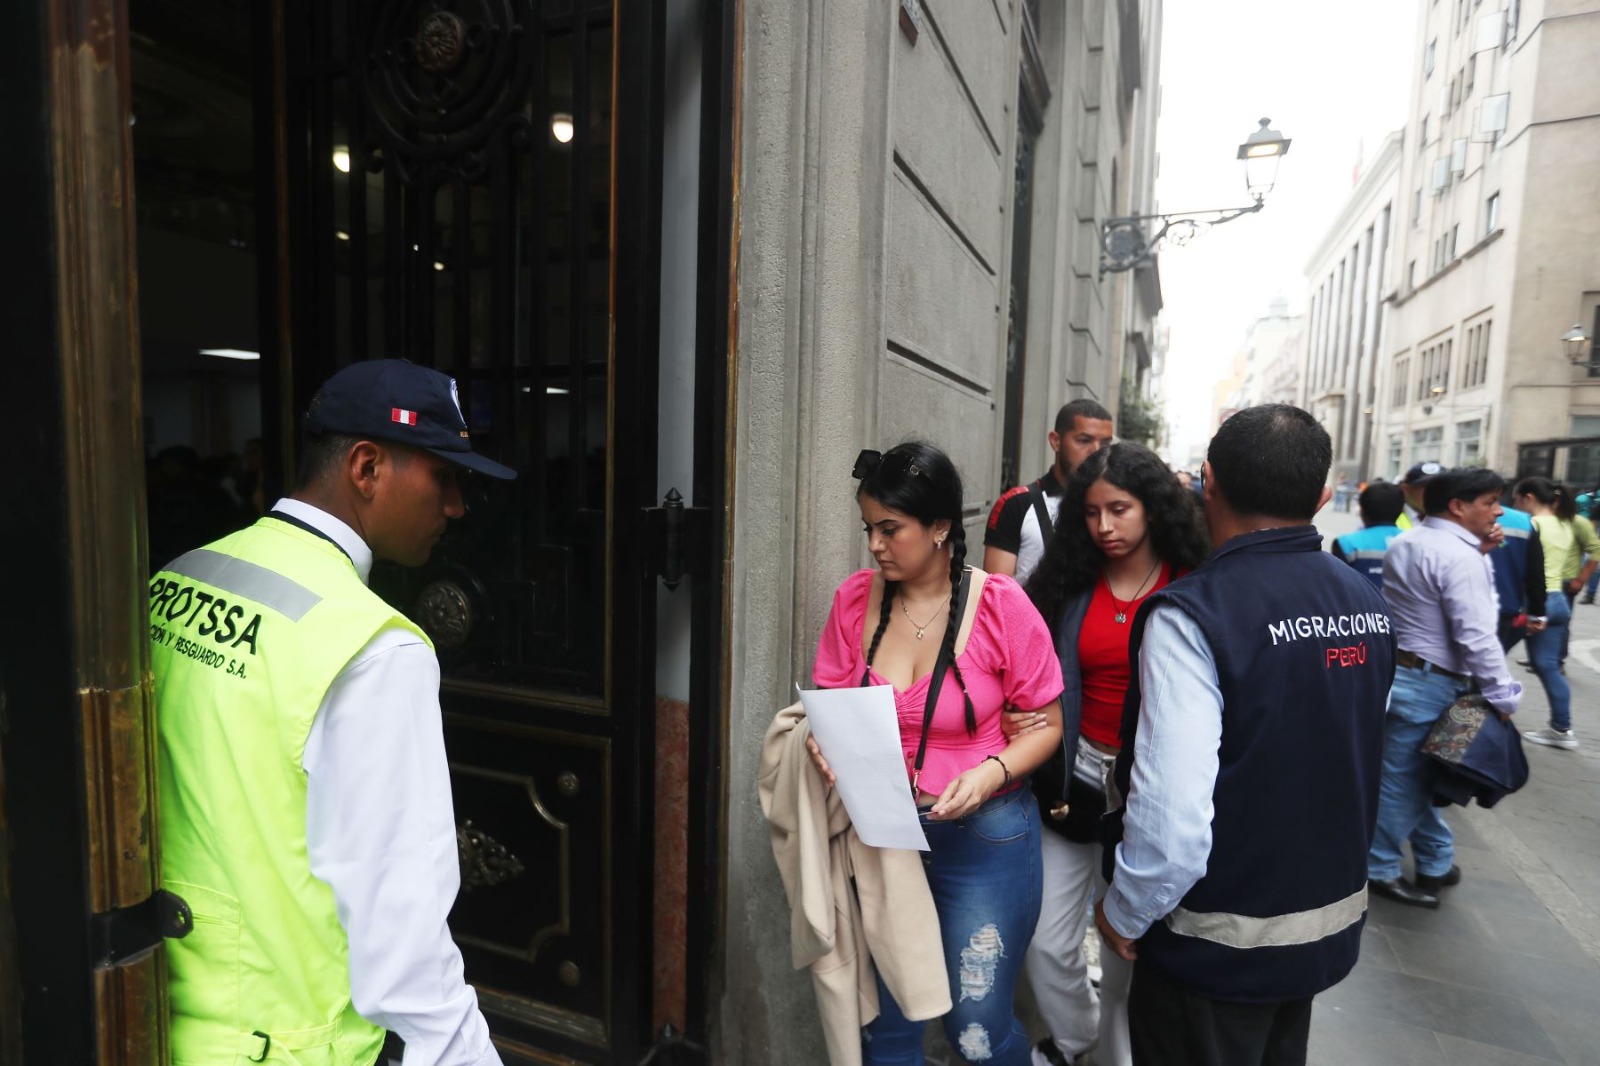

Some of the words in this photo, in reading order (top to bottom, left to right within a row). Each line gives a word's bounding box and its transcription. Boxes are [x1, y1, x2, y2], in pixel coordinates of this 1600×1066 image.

[150, 578, 262, 656] PROTSSA
[1268, 612, 1390, 645] MIGRACIONES
[165, 632, 175, 647] Y
[174, 636, 225, 669] RESGUARDO
[226, 659, 247, 679] S.A.
[1326, 641, 1367, 669] PERÚ
